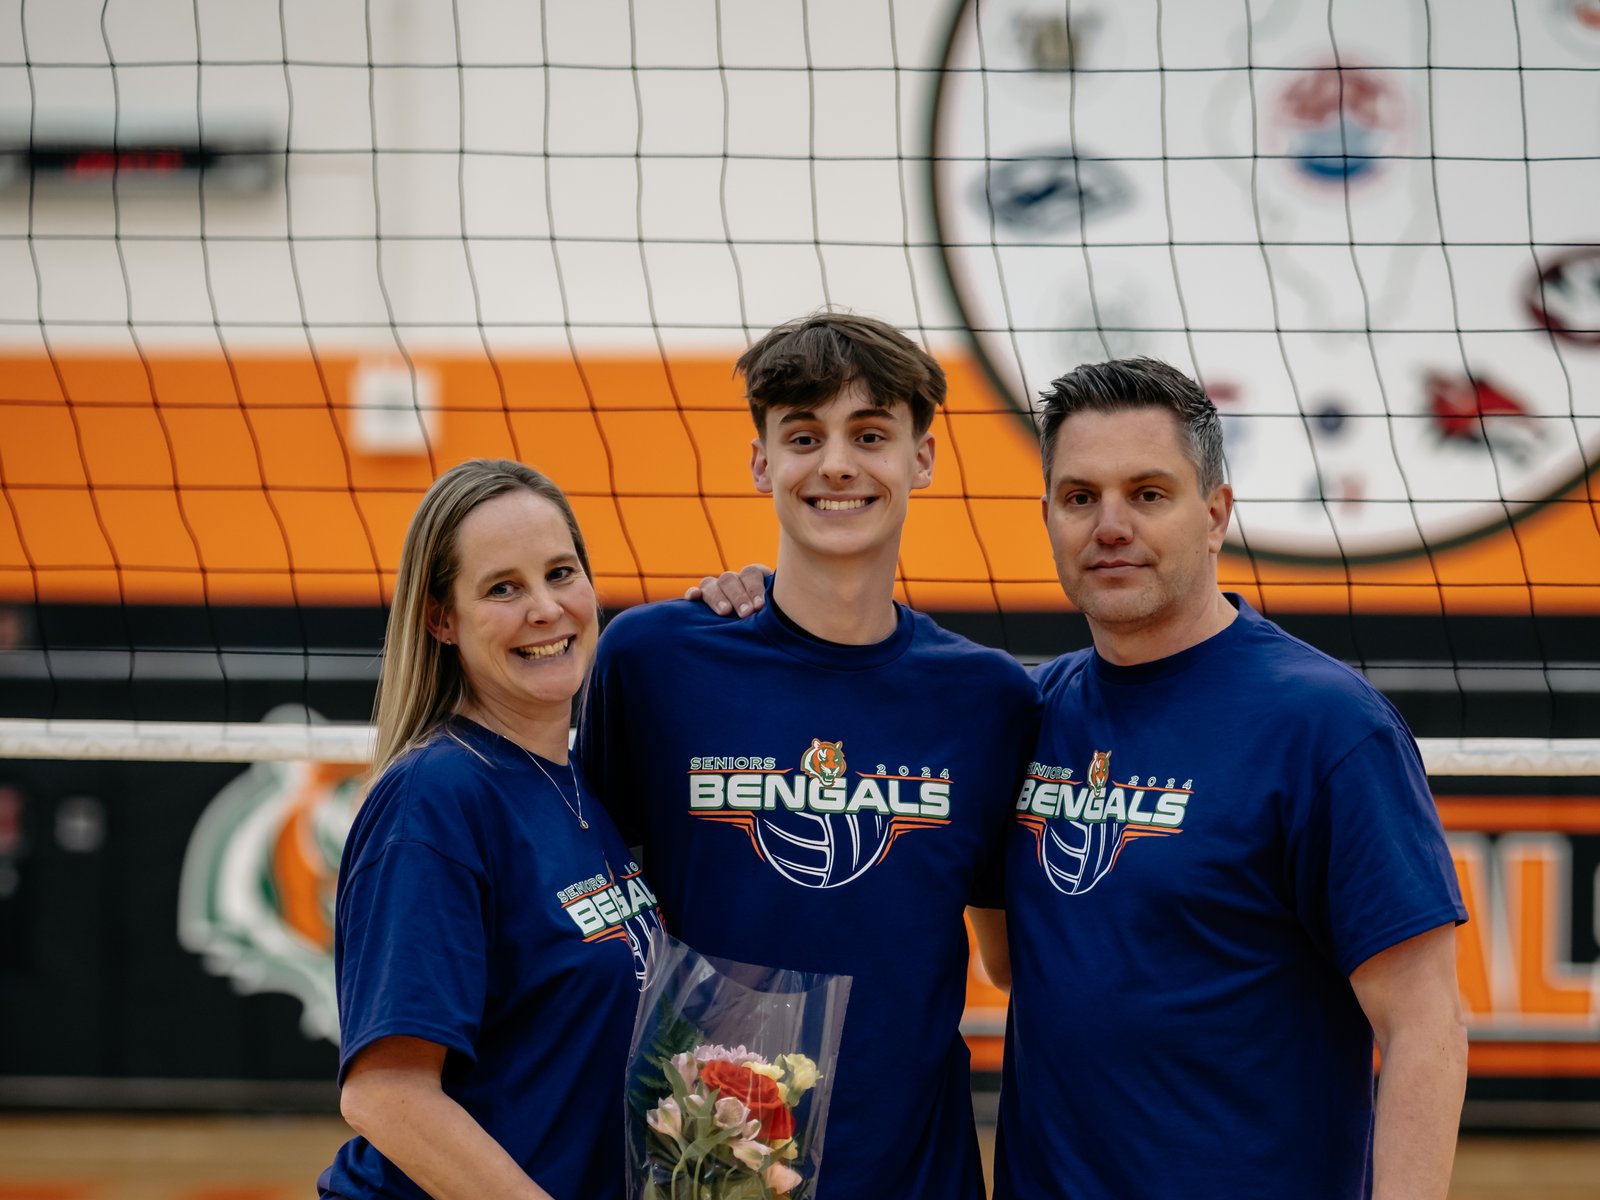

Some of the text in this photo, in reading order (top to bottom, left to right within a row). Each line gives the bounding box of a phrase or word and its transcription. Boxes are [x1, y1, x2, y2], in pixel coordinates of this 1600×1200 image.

[690, 756, 950, 779] SENIORS 2024
[1027, 761, 1193, 790] NIORS 2024
[689, 774, 951, 819] BENGALS
[1015, 779, 1190, 827] BENGALS
[556, 873, 607, 903] SENORS
